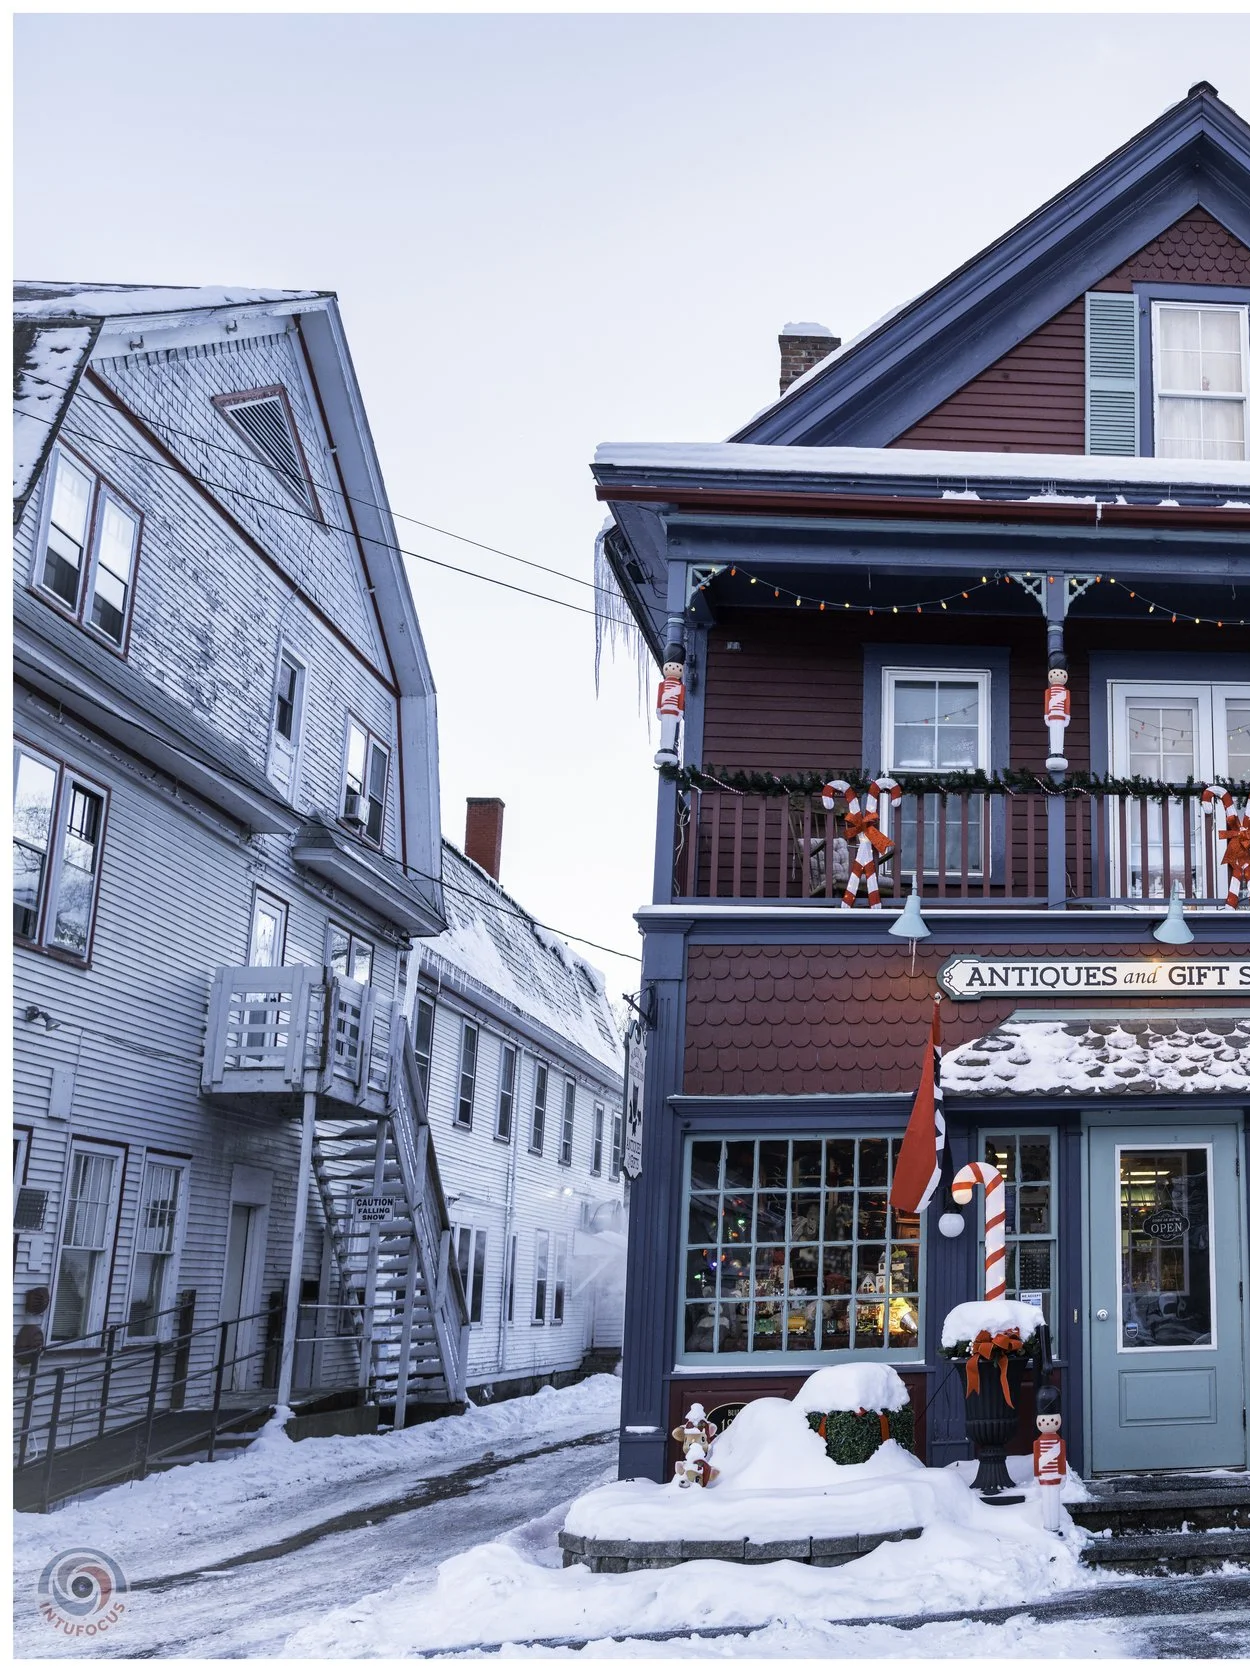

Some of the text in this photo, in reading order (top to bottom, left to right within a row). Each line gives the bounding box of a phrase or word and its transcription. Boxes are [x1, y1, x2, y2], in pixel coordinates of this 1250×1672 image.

[966, 966, 1118, 989] ANTIQUES
[1123, 965, 1162, 986] and
[1168, 965, 1230, 986] GIFT
[356, 1198, 394, 1207] CAUTION
[1151, 1222, 1182, 1233] OPEN
